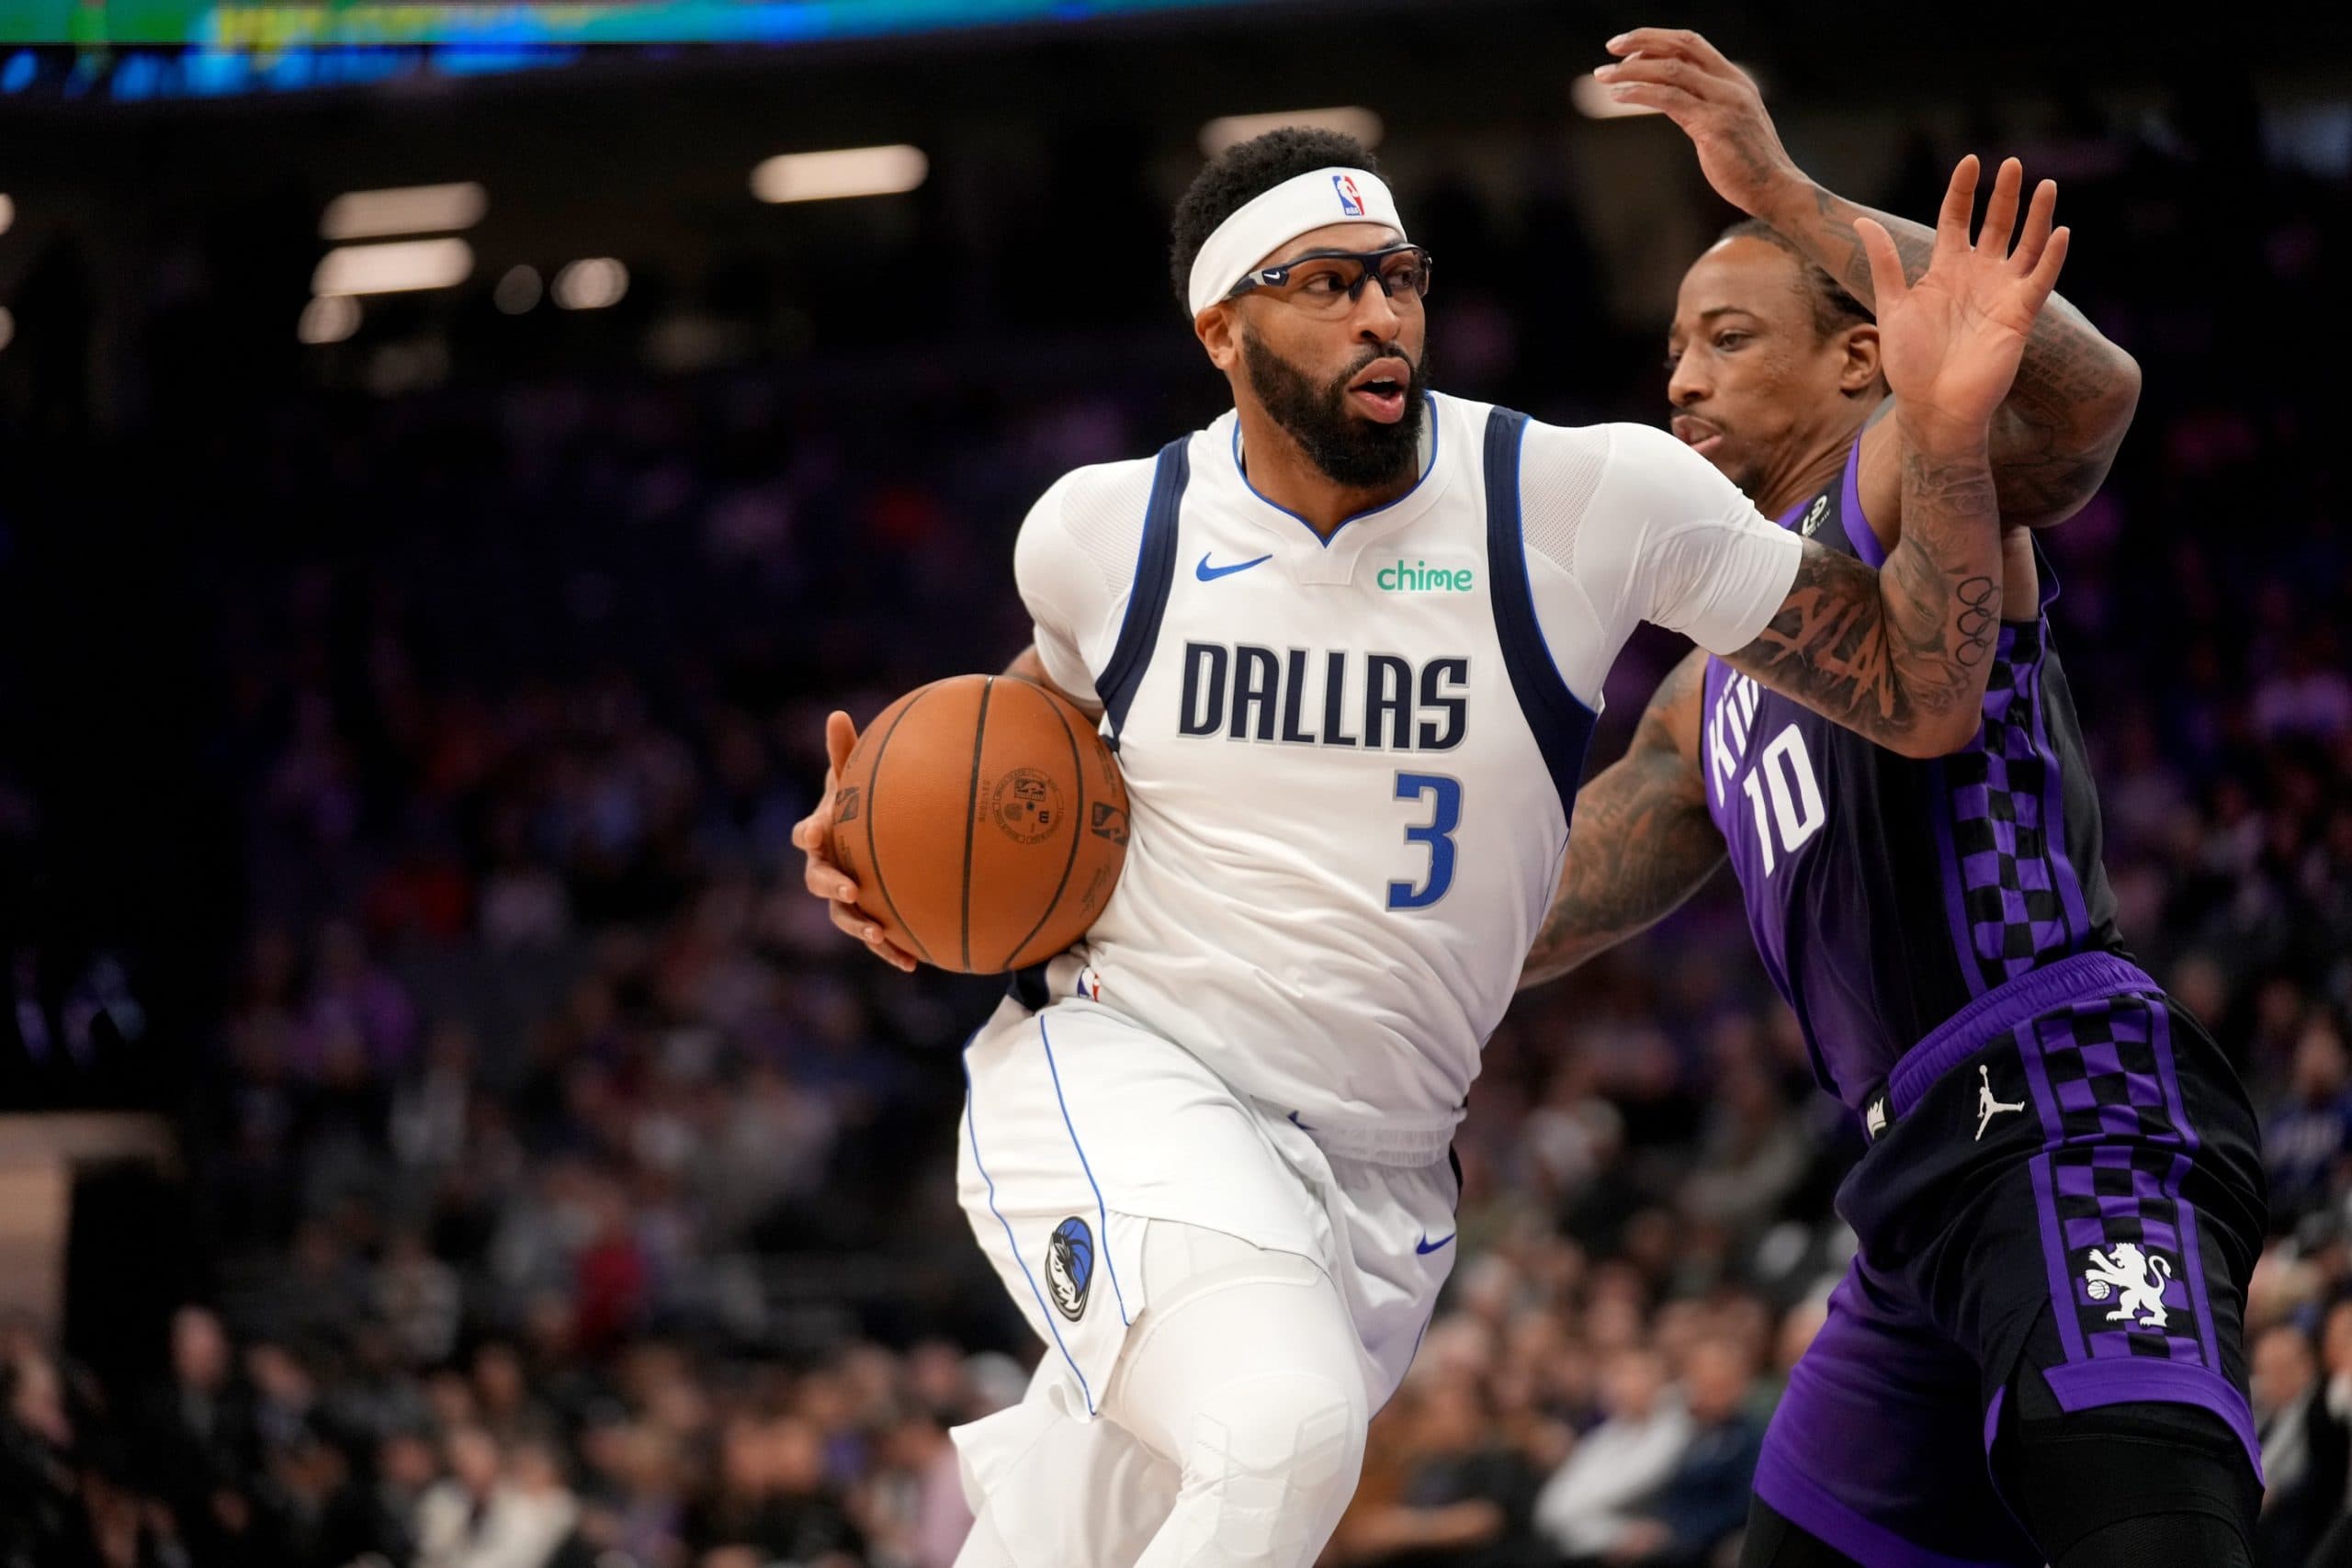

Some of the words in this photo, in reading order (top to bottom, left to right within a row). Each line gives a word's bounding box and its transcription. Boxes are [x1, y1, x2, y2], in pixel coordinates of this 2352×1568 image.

[1377, 559, 1472, 591] chime
[1176, 639, 1472, 752] DALLAS
[1385, 771, 1464, 912] 3
[1743, 723, 1826, 879] 10
